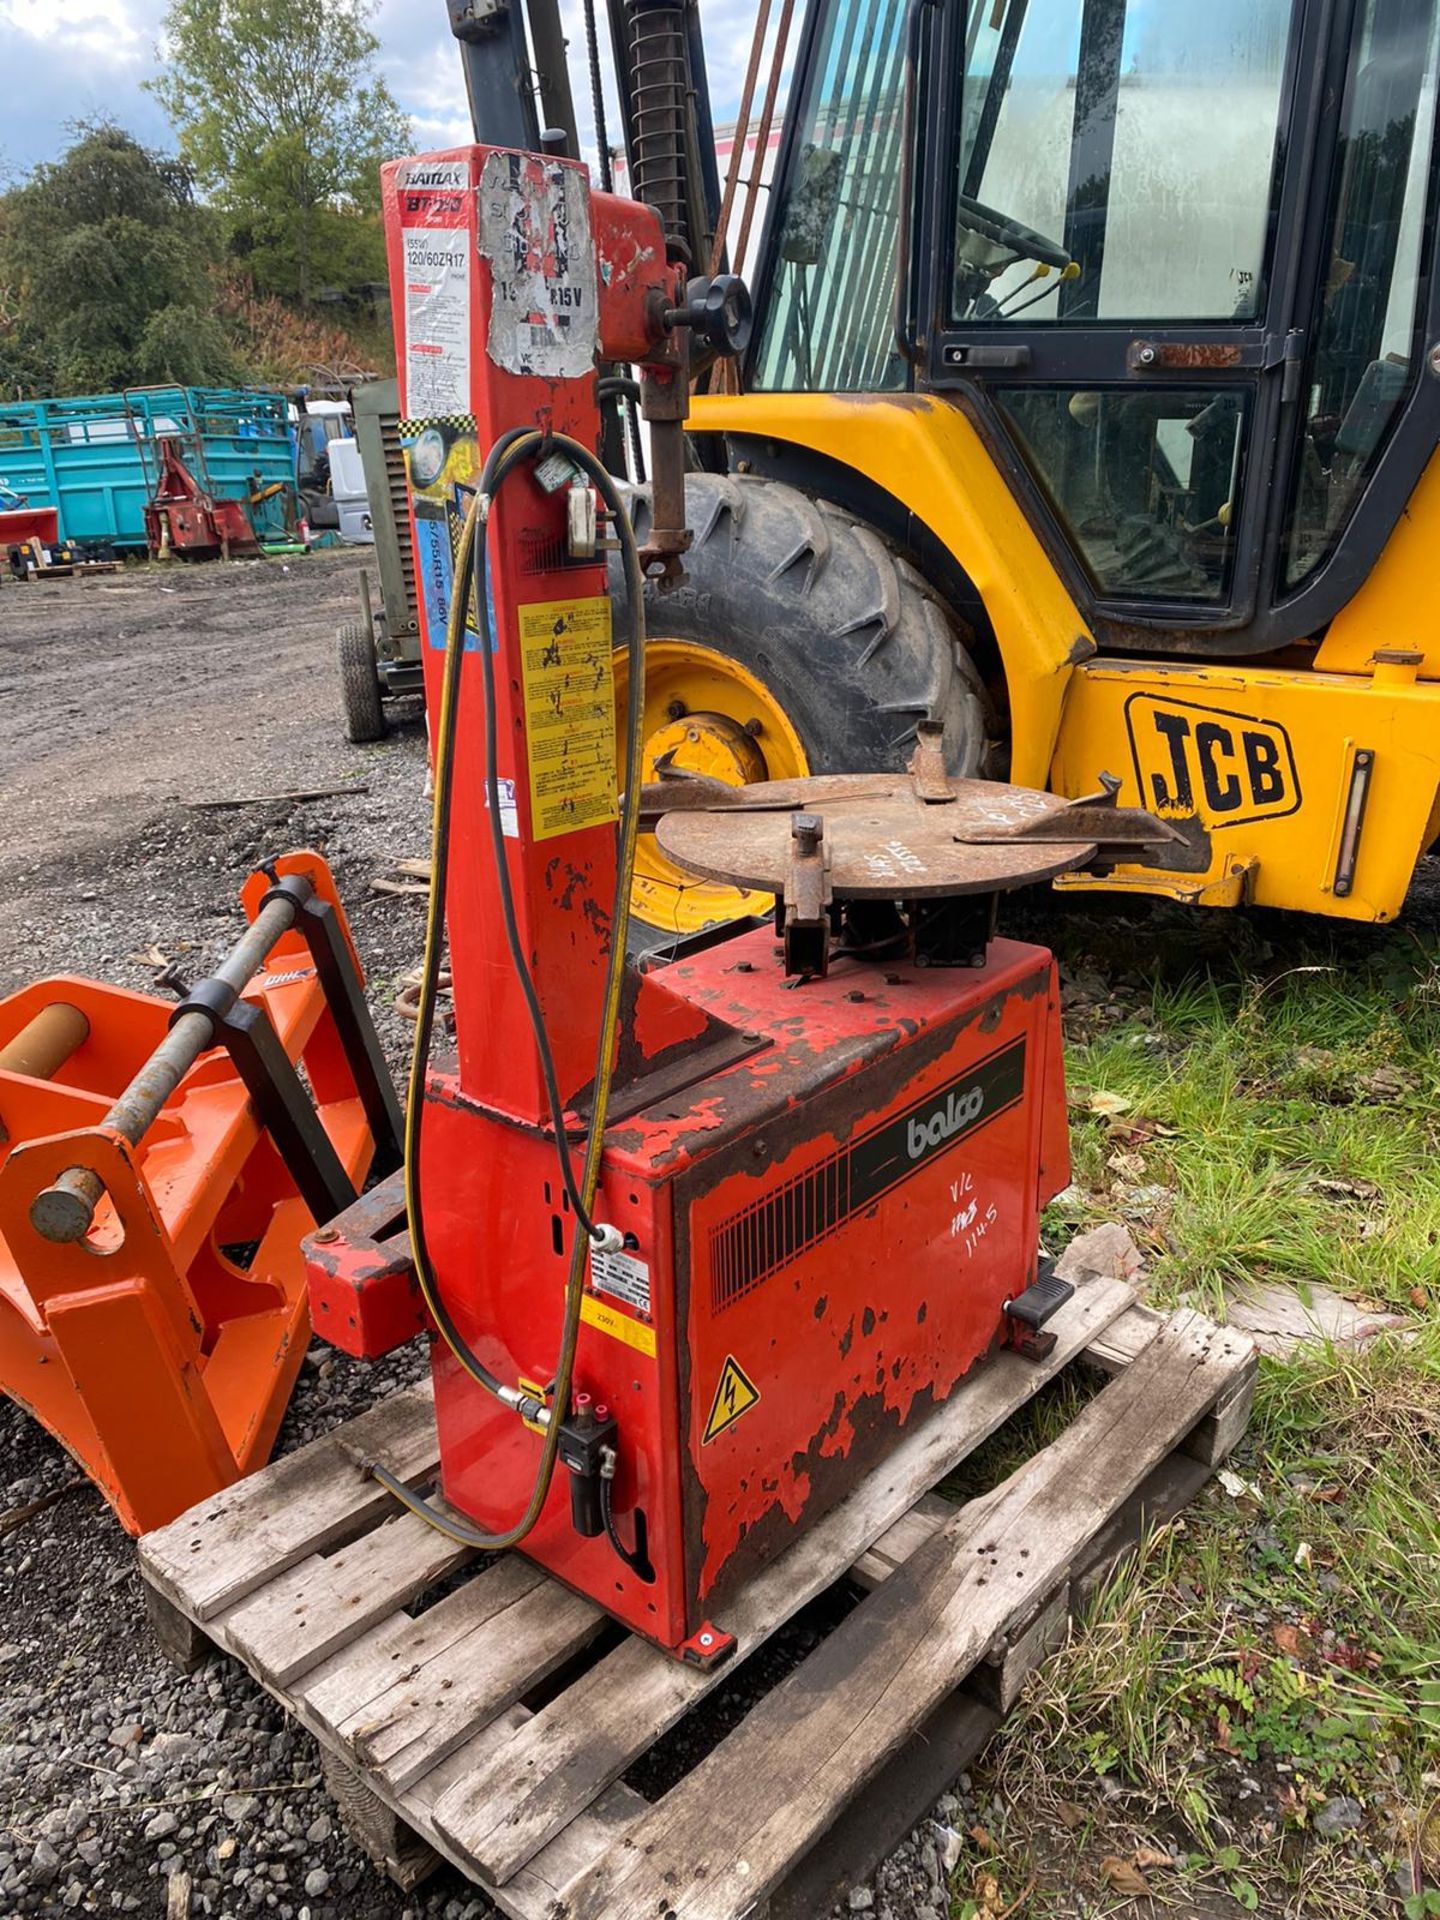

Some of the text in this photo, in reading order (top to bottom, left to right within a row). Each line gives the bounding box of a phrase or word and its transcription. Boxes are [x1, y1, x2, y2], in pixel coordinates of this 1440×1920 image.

[407, 251, 465, 268] 120/60ZR17
[1151, 710, 1285, 812] JCB
[906, 1085, 985, 1160] balco
